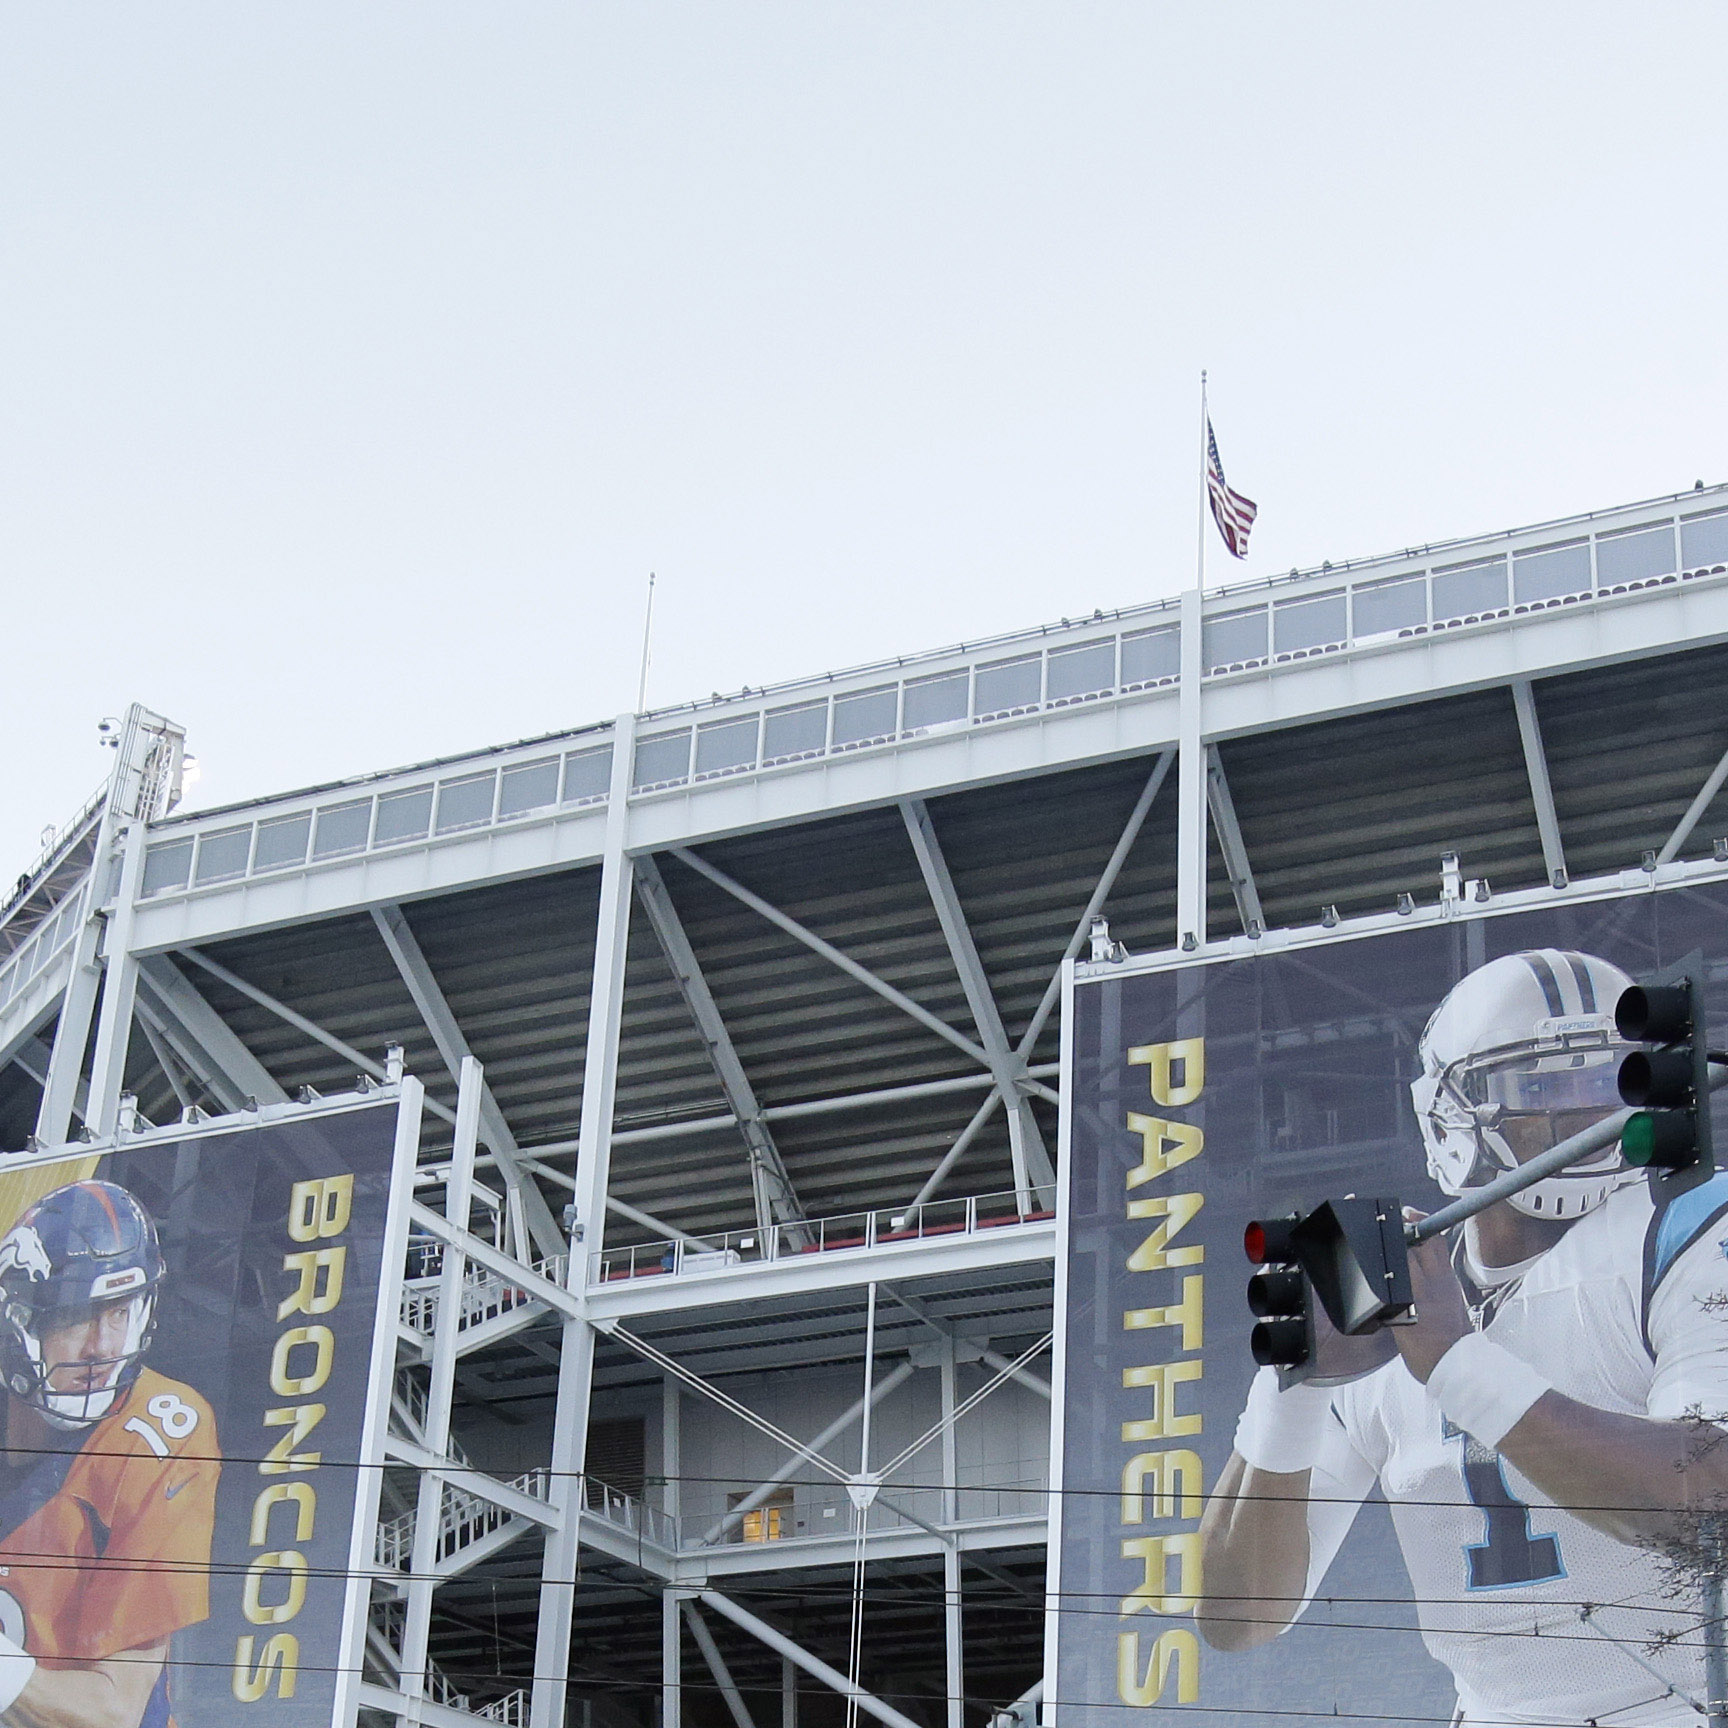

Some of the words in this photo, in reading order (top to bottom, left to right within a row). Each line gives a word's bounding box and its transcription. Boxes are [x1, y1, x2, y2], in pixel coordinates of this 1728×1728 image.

[123, 1393, 200, 1462] 18
[231, 1173, 354, 1702] BRONCOS
[1117, 1037, 1205, 1707] PANTHERS
[1440, 1408, 1569, 1591] 1
